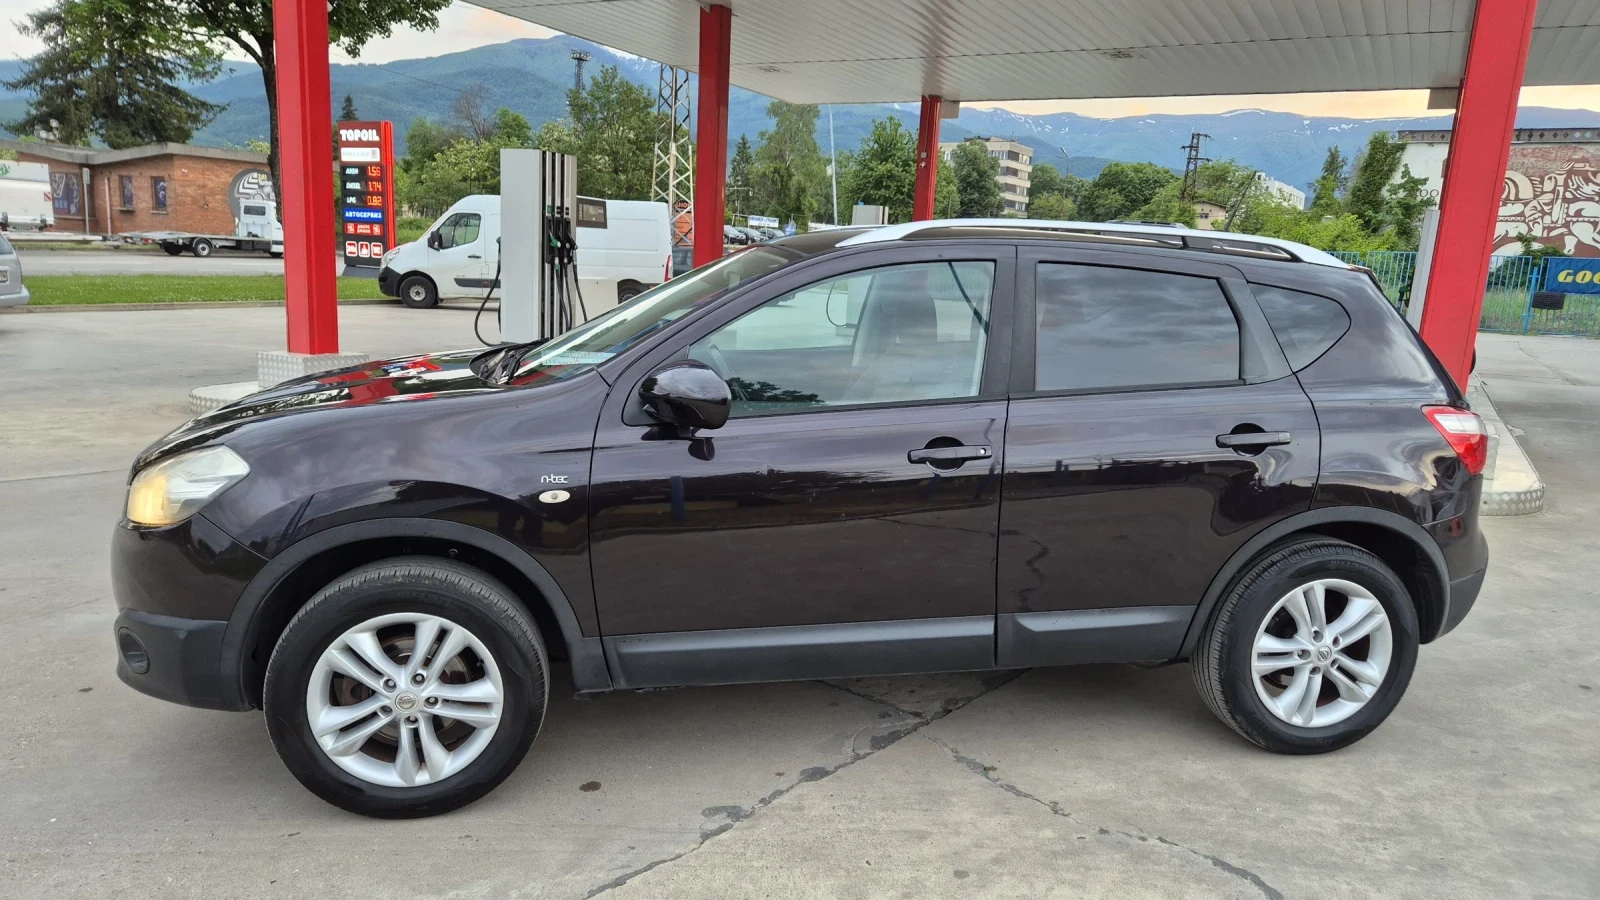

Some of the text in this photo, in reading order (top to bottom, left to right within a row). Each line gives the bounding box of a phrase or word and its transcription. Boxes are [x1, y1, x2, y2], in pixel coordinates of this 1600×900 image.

[340, 129, 380, 141] TOPOIL
[346, 181, 382, 192] DIESEL 1.74
[346, 195, 382, 206] LPG 0.82
[345, 211, 382, 219] АВТОСЕРВИЗ
[540, 473, 569, 484] n-tec
